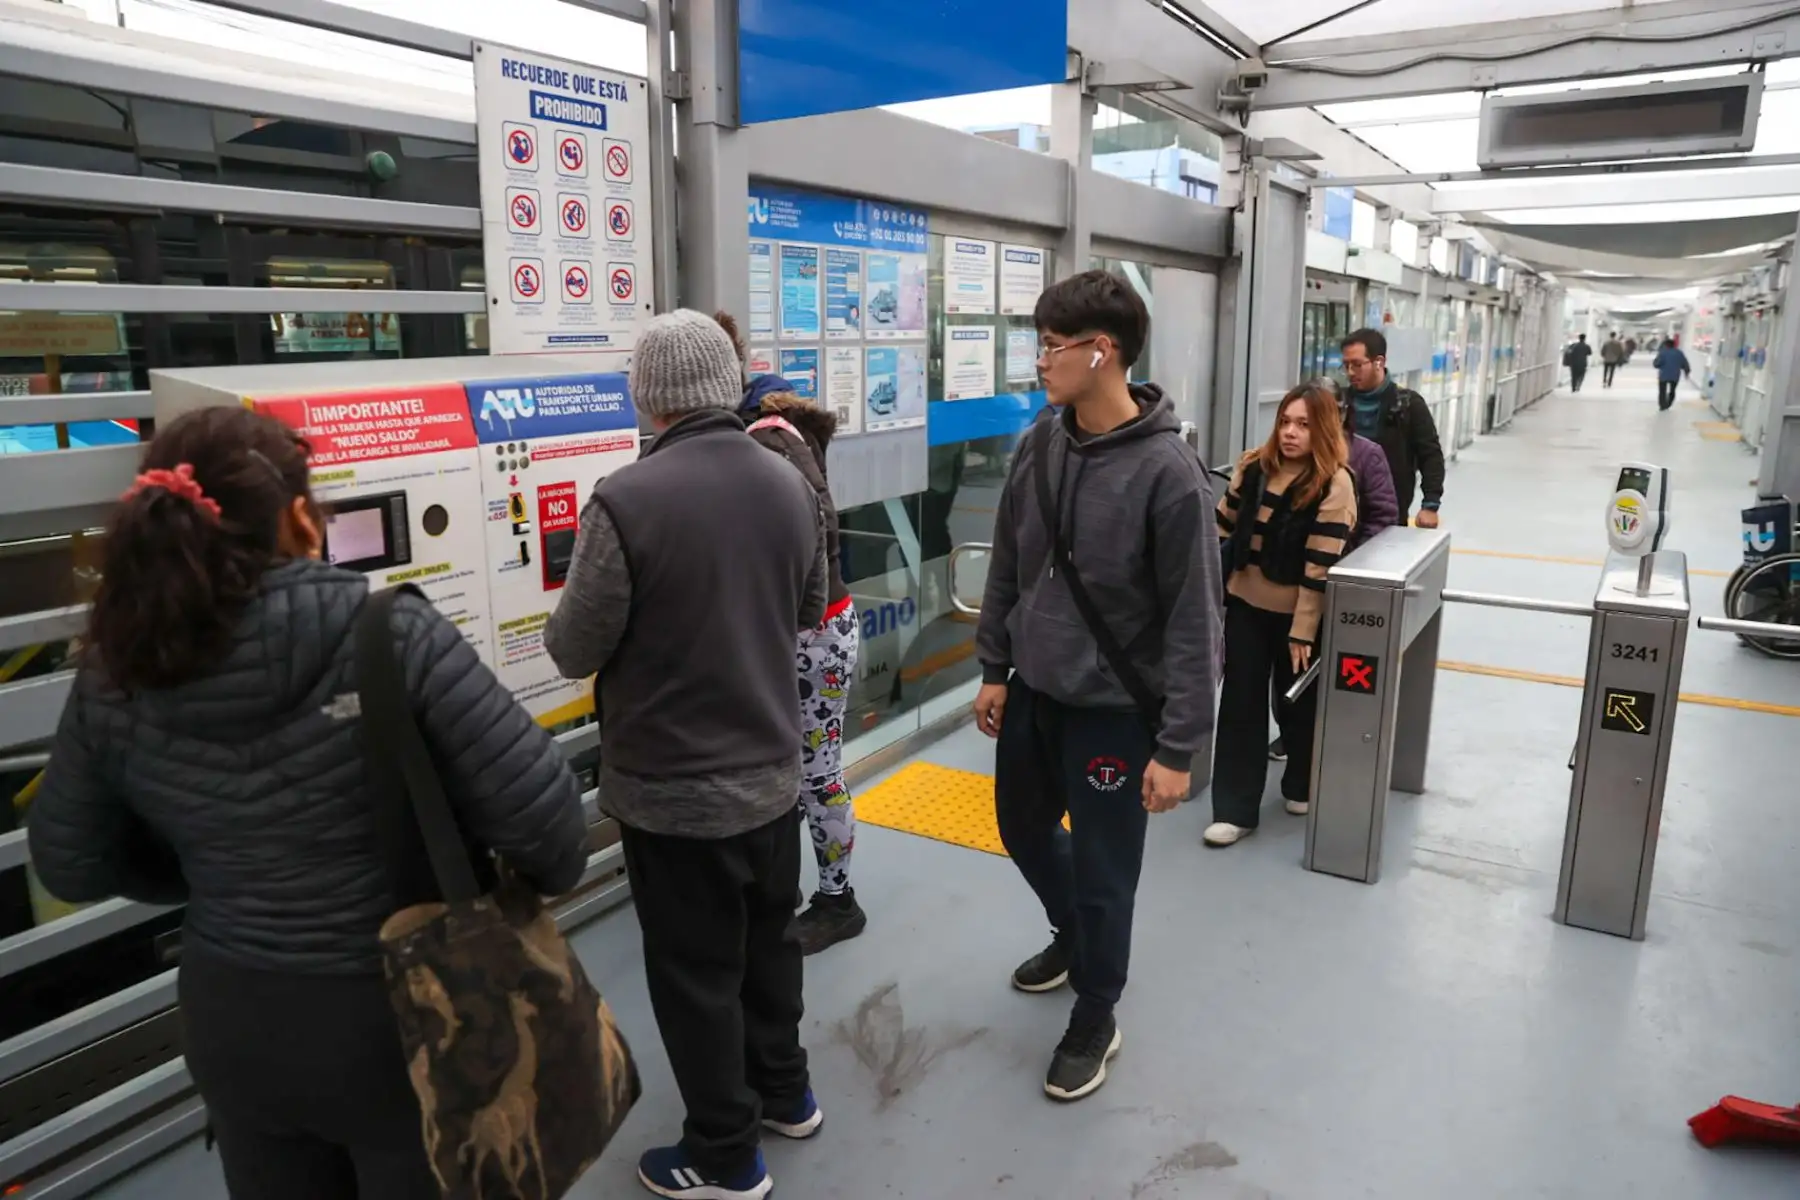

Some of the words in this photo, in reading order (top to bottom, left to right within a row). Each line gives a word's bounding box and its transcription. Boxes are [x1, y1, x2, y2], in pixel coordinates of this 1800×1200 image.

[501, 58, 569, 90] RECUERDE
[573, 74, 596, 95] QUE
[599, 80, 628, 102] ESTÁ
[534, 95, 602, 125] PROHIBIDO
[748, 196, 768, 224] TU
[535, 385, 583, 396] AUTORIDAD
[584, 384, 595, 393] DE
[537, 394, 591, 406] TRANSPORTE
[591, 392, 624, 402] URBANO
[312, 399, 425, 423] ¡IMPORTANTE!
[480, 387, 536, 421] ATU
[539, 406, 561, 416] PARA
[562, 404, 582, 415] LIMA
[582, 404, 588, 413] Y
[589, 402, 620, 412] CALLAO
[325, 424, 338, 434] LA
[338, 421, 375, 433] TARJETA
[375, 418, 404, 429] HASTA
[404, 416, 421, 427] QUE
[314, 451, 334, 464] QUE
[335, 449, 348, 461] LA
[349, 444, 389, 459] RECARGA
[389, 443, 401, 454] SE
[548, 500, 568, 516] NO
[1742, 521, 1775, 552] TU
[862, 597, 915, 640] ano
[1611, 643, 1658, 662] 3241
